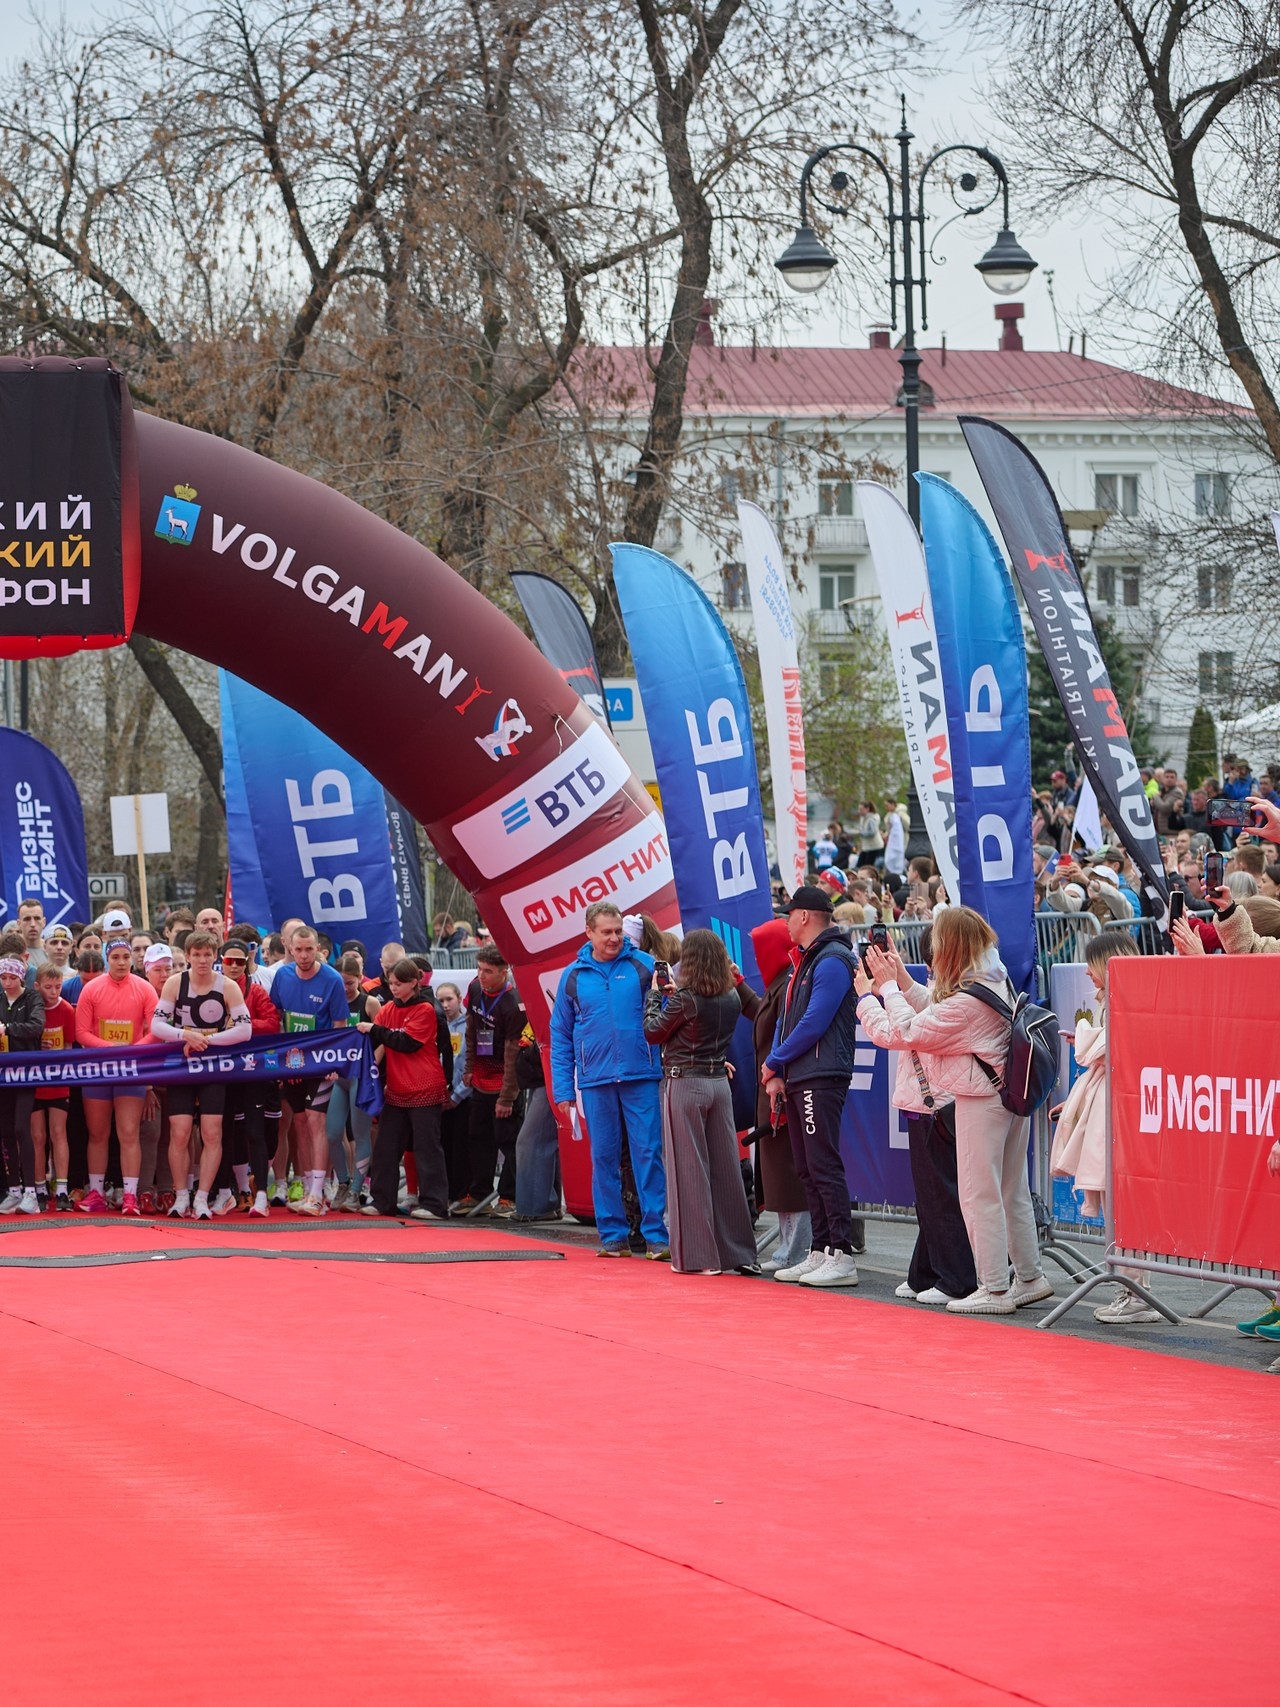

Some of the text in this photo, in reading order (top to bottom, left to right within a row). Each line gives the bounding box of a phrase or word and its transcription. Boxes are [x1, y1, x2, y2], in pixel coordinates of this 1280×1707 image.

[210, 513, 468, 699] VOLGAMAN
[534, 757, 606, 828] ВТБ
[684, 697, 758, 901] ВТБ
[15, 781, 41, 891] БИЗНЕС
[34, 799, 59, 899] ГАРАНТ
[285, 768, 367, 924] ВТБ
[89, 879, 117, 895] ОП
[108, 1030, 129, 1041] 3471
[188, 1054, 235, 1074] ВТБ
[293, 1022, 309, 1032] 778
